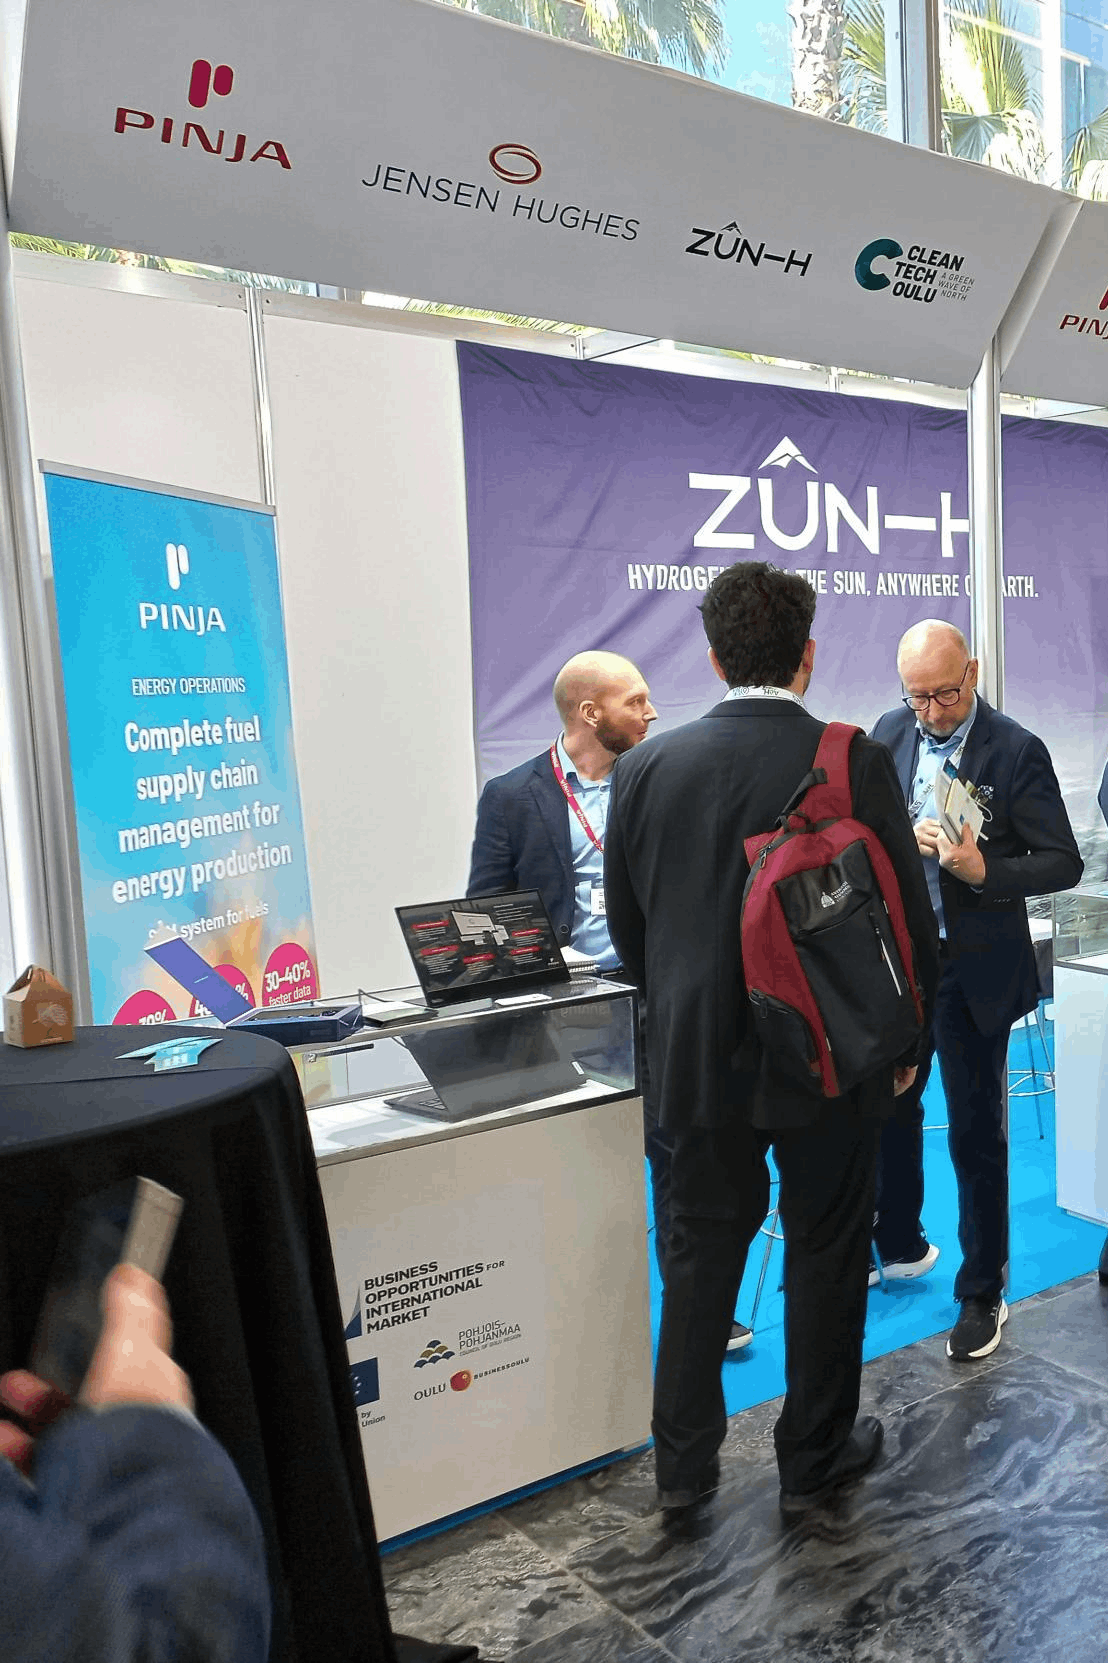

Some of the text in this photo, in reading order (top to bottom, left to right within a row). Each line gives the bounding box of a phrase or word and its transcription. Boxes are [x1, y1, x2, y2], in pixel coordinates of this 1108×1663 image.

[113, 107, 293, 170] PINJA
[362, 164, 641, 242] JENSEN HUGHES
[907, 245, 965, 272] CLEAN
[893, 261, 938, 285] TECH
[938, 280, 972, 293] WAVE OF
[949, 273, 976, 285] GREEN
[892, 281, 938, 303] OULU
[941, 290, 968, 301] NORTH
[627, 563, 731, 592] HYDROGE
[833, 570, 872, 598] SUN,
[876, 572, 960, 597] ANYWHERE
[1001, 575, 1040, 598] ARTH.
[138, 602, 227, 636] PINJA
[131, 677, 246, 696] ENERGY OPERATIONS
[124, 714, 262, 756] Complete fuel
[136, 758, 259, 804] supply chain
[117, 801, 281, 854] management for
[111, 843, 294, 904] energy production
[181, 916, 225, 941] system
[294, 985, 311, 1000] data
[364, 1261, 439, 1291] BUSINESS
[365, 1260, 505, 1305] OPPORTUNITIES FOR
[366, 1277, 483, 1320] INTERNATIONAL
[367, 1306, 431, 1335] MARKET
[459, 1320, 506, 1341] POHJOIS-
[459, 1324, 521, 1350] POHJANMAA
[413, 1356, 530, 1401] OULU BUSINESSOULU
[361, 1410, 371, 1419] by
[361, 1415, 386, 1428] Union
